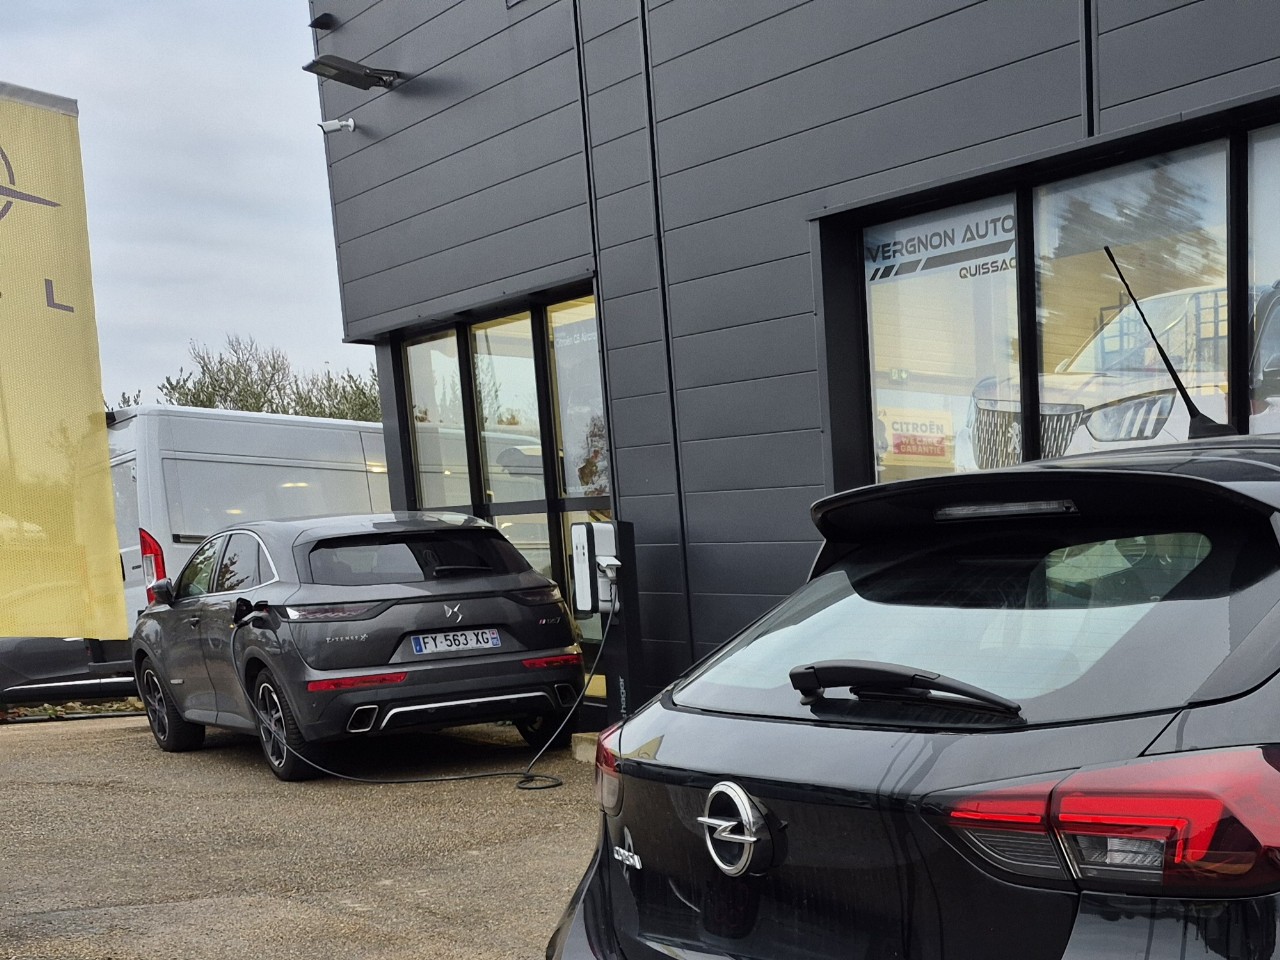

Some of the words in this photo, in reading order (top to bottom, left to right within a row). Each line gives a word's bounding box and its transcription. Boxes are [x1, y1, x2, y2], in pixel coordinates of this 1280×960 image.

[866, 227, 955, 264] VERGNON
[961, 214, 1016, 244] AUTO
[959, 256, 1016, 279] QUISSAC
